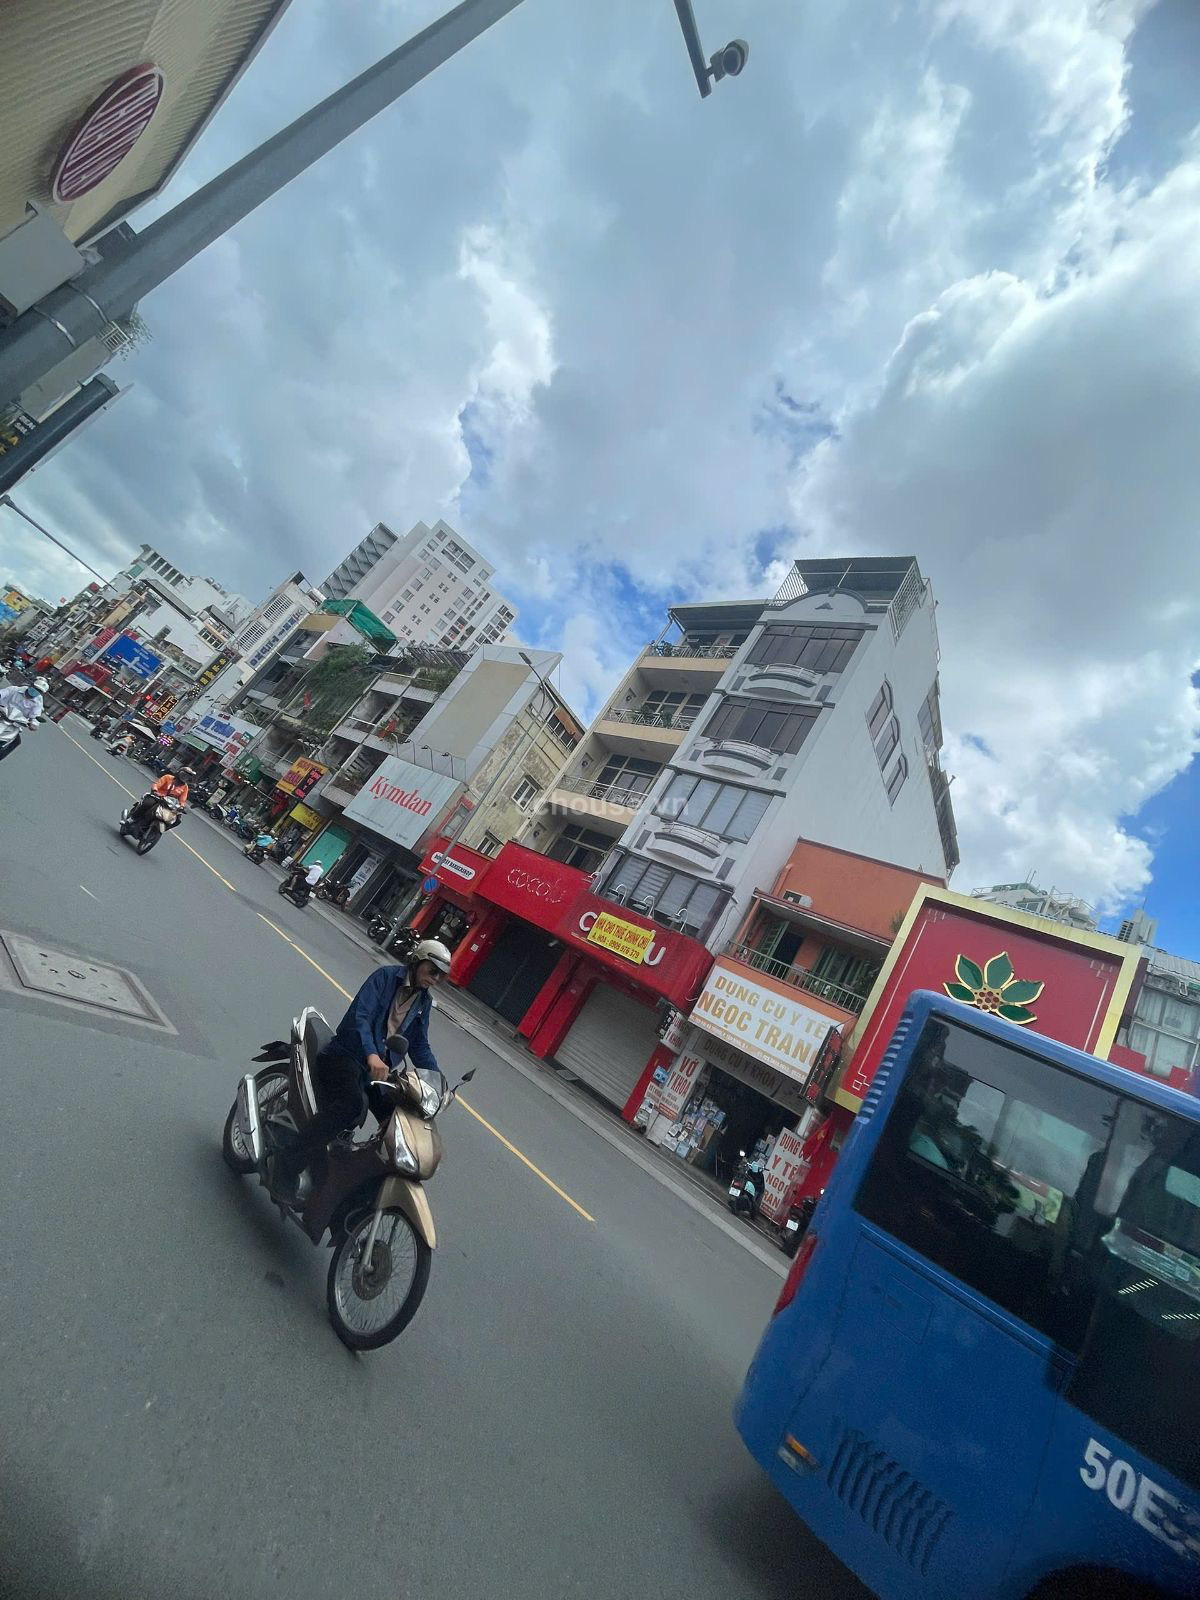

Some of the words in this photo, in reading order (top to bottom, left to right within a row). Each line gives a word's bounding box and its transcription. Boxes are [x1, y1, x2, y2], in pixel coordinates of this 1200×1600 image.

[369, 775, 433, 817] Kymdan
[697, 991, 752, 1032] NGỌC
[714, 975, 760, 1008] DỤNG
[761, 998, 788, 1022] CỤ
[790, 1011, 802, 1026] Y
[779, 1133, 801, 1156] DỤNG
[771, 1155, 781, 1170] Y
[763, 1189, 782, 1209] RAN
